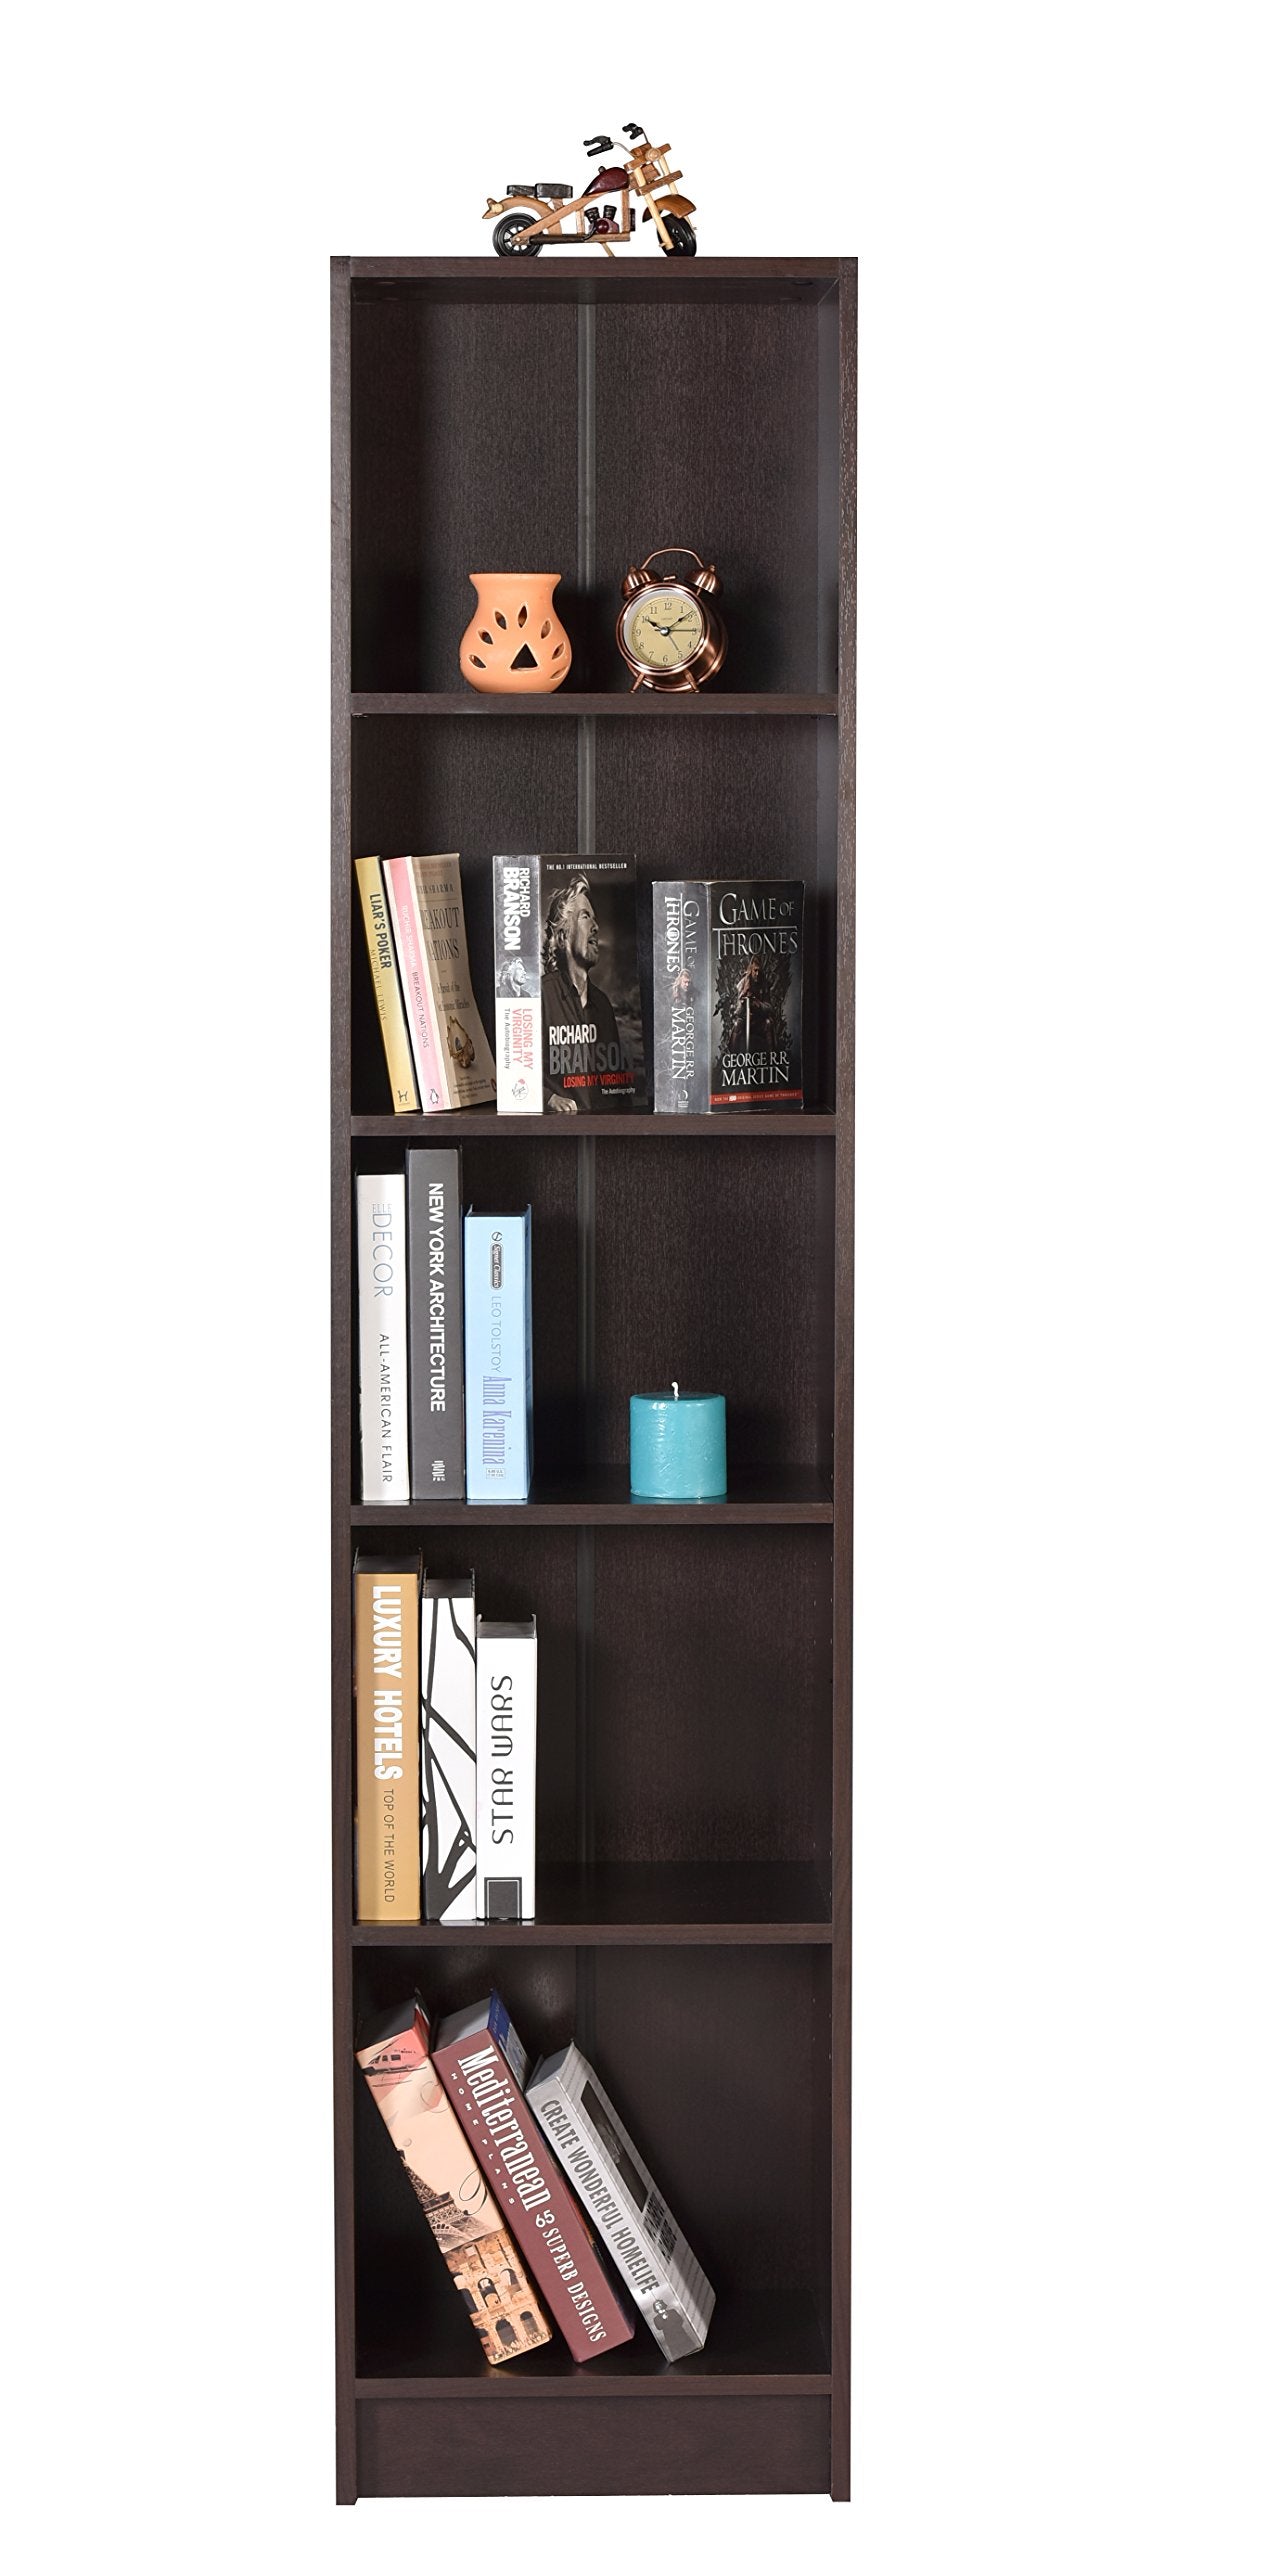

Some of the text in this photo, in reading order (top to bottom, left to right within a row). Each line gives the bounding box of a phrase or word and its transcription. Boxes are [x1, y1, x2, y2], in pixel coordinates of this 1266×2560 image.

[650, 606, 657, 614] 11
[664, 602, 673, 611] 12
[520, 867, 531, 918] RICHARD
[599, 862, 627, 870] BESTSELLER
[370, 893, 392, 969] LIAR'S POKER
[503, 866, 521, 951] BRANSON
[664, 893, 683, 973] THRONES
[683, 900, 700, 969] GAME OF
[719, 892, 795, 925] GAME OF
[712, 926, 798, 960] THRONES
[411, 971, 424, 1012] BREAKOUT
[418, 1014, 429, 1048] NATIONS
[512, 1008, 523, 1063] VIRGINITY
[549, 1023, 597, 1046] RICHARD
[685, 1006, 695, 1057] GEORGE
[503, 1022, 511, 1069] Autobiography
[522, 1008, 533, 1070] LOSING MY
[549, 1041, 633, 1075] BRANSON
[671, 1006, 687, 1080] MARTIN
[722, 1051, 768, 1068] GEORGE
[563, 1071, 635, 1089] LOSING MY VIRGINITY
[722, 1066, 790, 1087] MARTIN
[372, 1213, 394, 1298] DECOR
[428, 1182, 446, 1412] NEW YORK ARCHITECTURE
[490, 1296, 502, 1373] LEO TOLSTOY
[379, 1333, 393, 1483] ALL-AMERICAN FLAIR
[482, 1375, 512, 1405] Anna
[482, 1410, 512, 1465] Karenina
[372, 1585, 403, 1903] LUXURY HOTELS TOP OF THE WORLD
[490, 1675, 514, 1845] STAR WARS
[451, 2072, 516, 2205] HOME PLANS
[457, 2045, 552, 2212] Mediterranean
[542, 2227, 579, 2281] SUPERB
[567, 2281, 607, 2342] DESIGNS
[540, 2099, 580, 2150] CREATE
[567, 2145, 624, 2230] WONDERFUL
[611, 2226, 660, 2295] HOMELIFE
